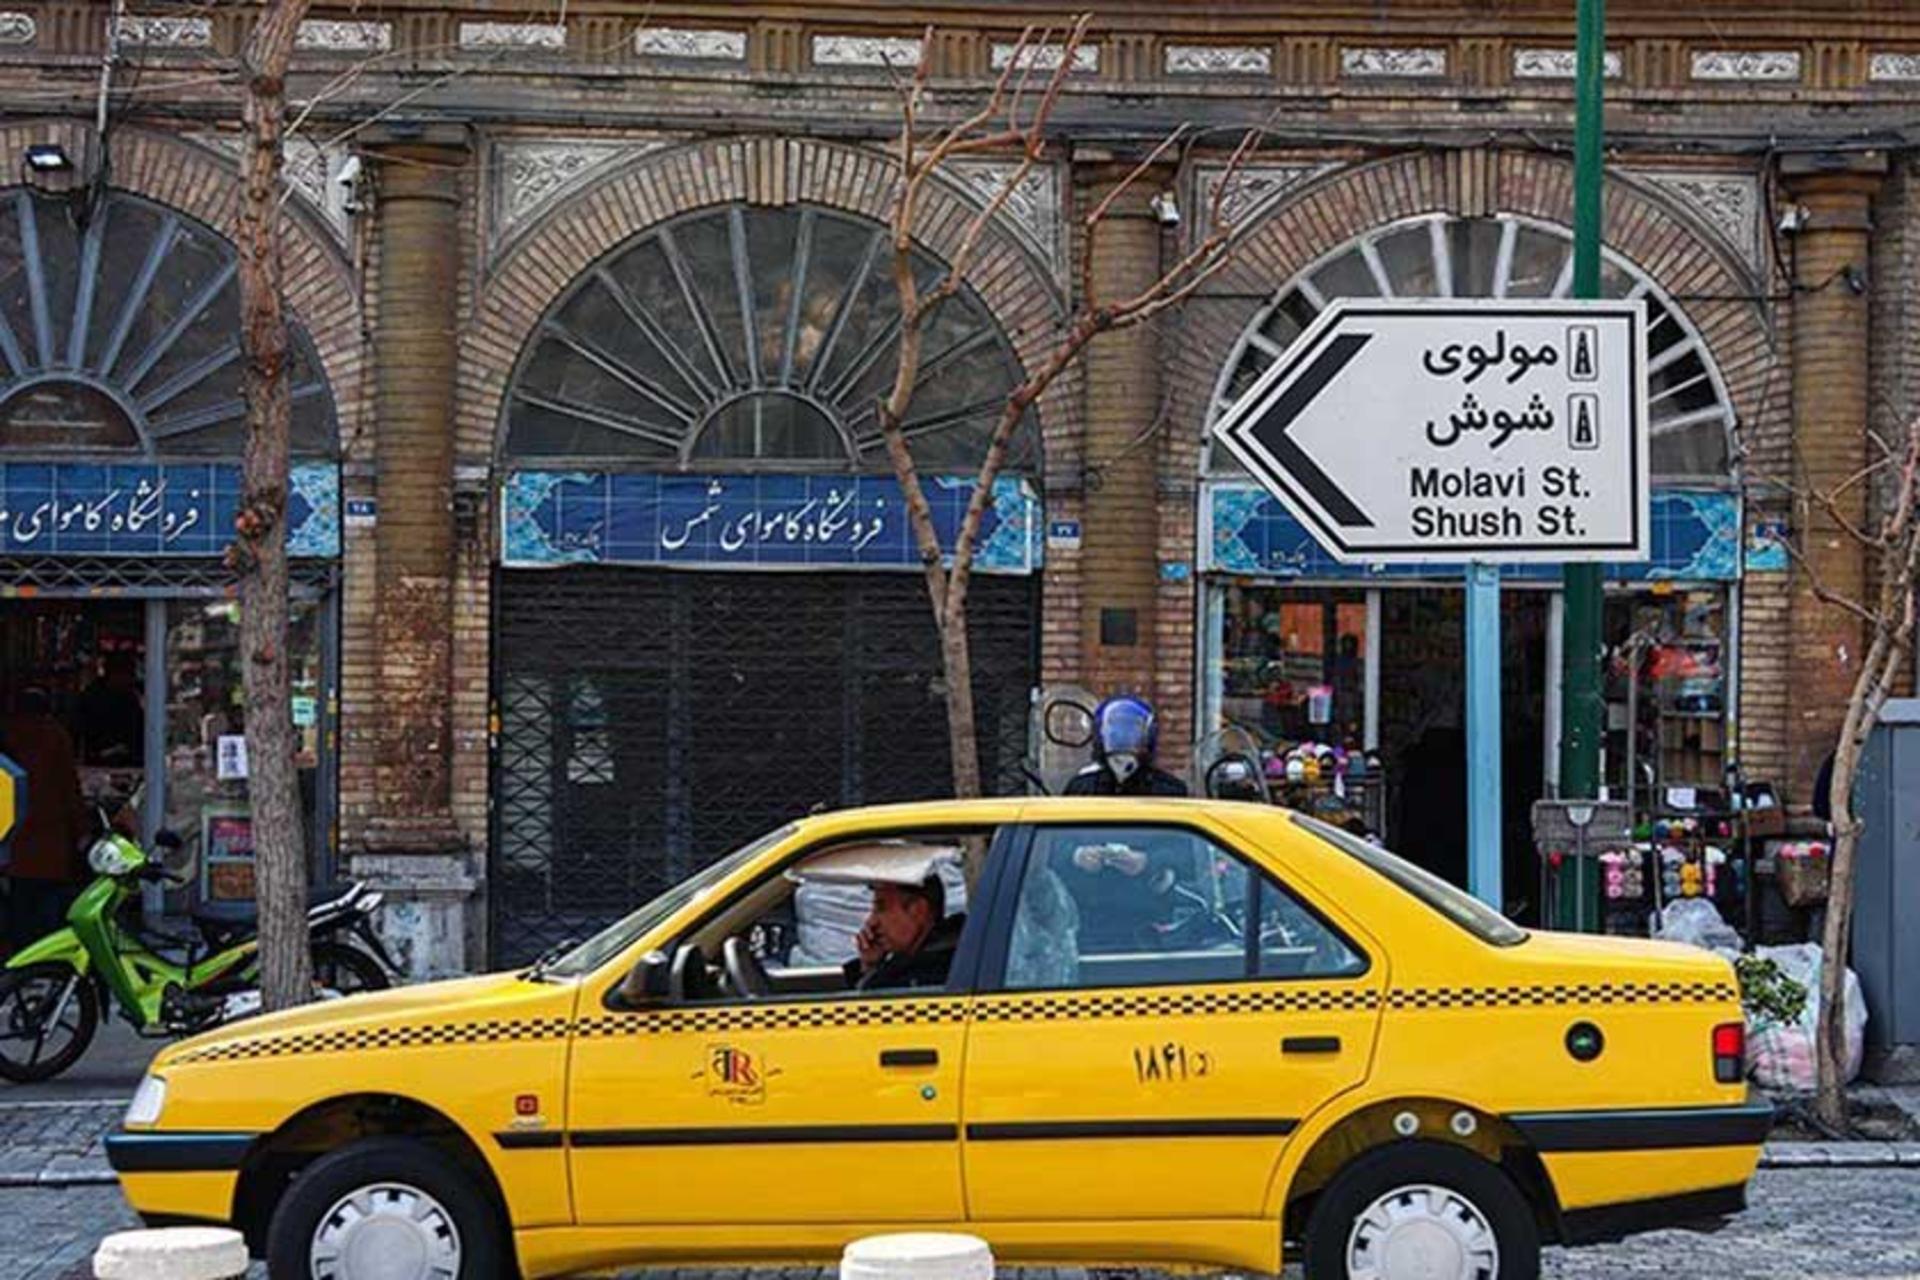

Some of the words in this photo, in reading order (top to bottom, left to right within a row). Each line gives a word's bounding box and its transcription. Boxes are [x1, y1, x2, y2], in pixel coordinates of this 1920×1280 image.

[1423, 330, 1558, 383] مولوی
[1426, 393, 1555, 447] شوش
[1411, 467, 1525, 497] Molavi
[1542, 467, 1590, 497] St.
[1412, 506, 1521, 537] Shush
[1538, 505, 1586, 536] St.
